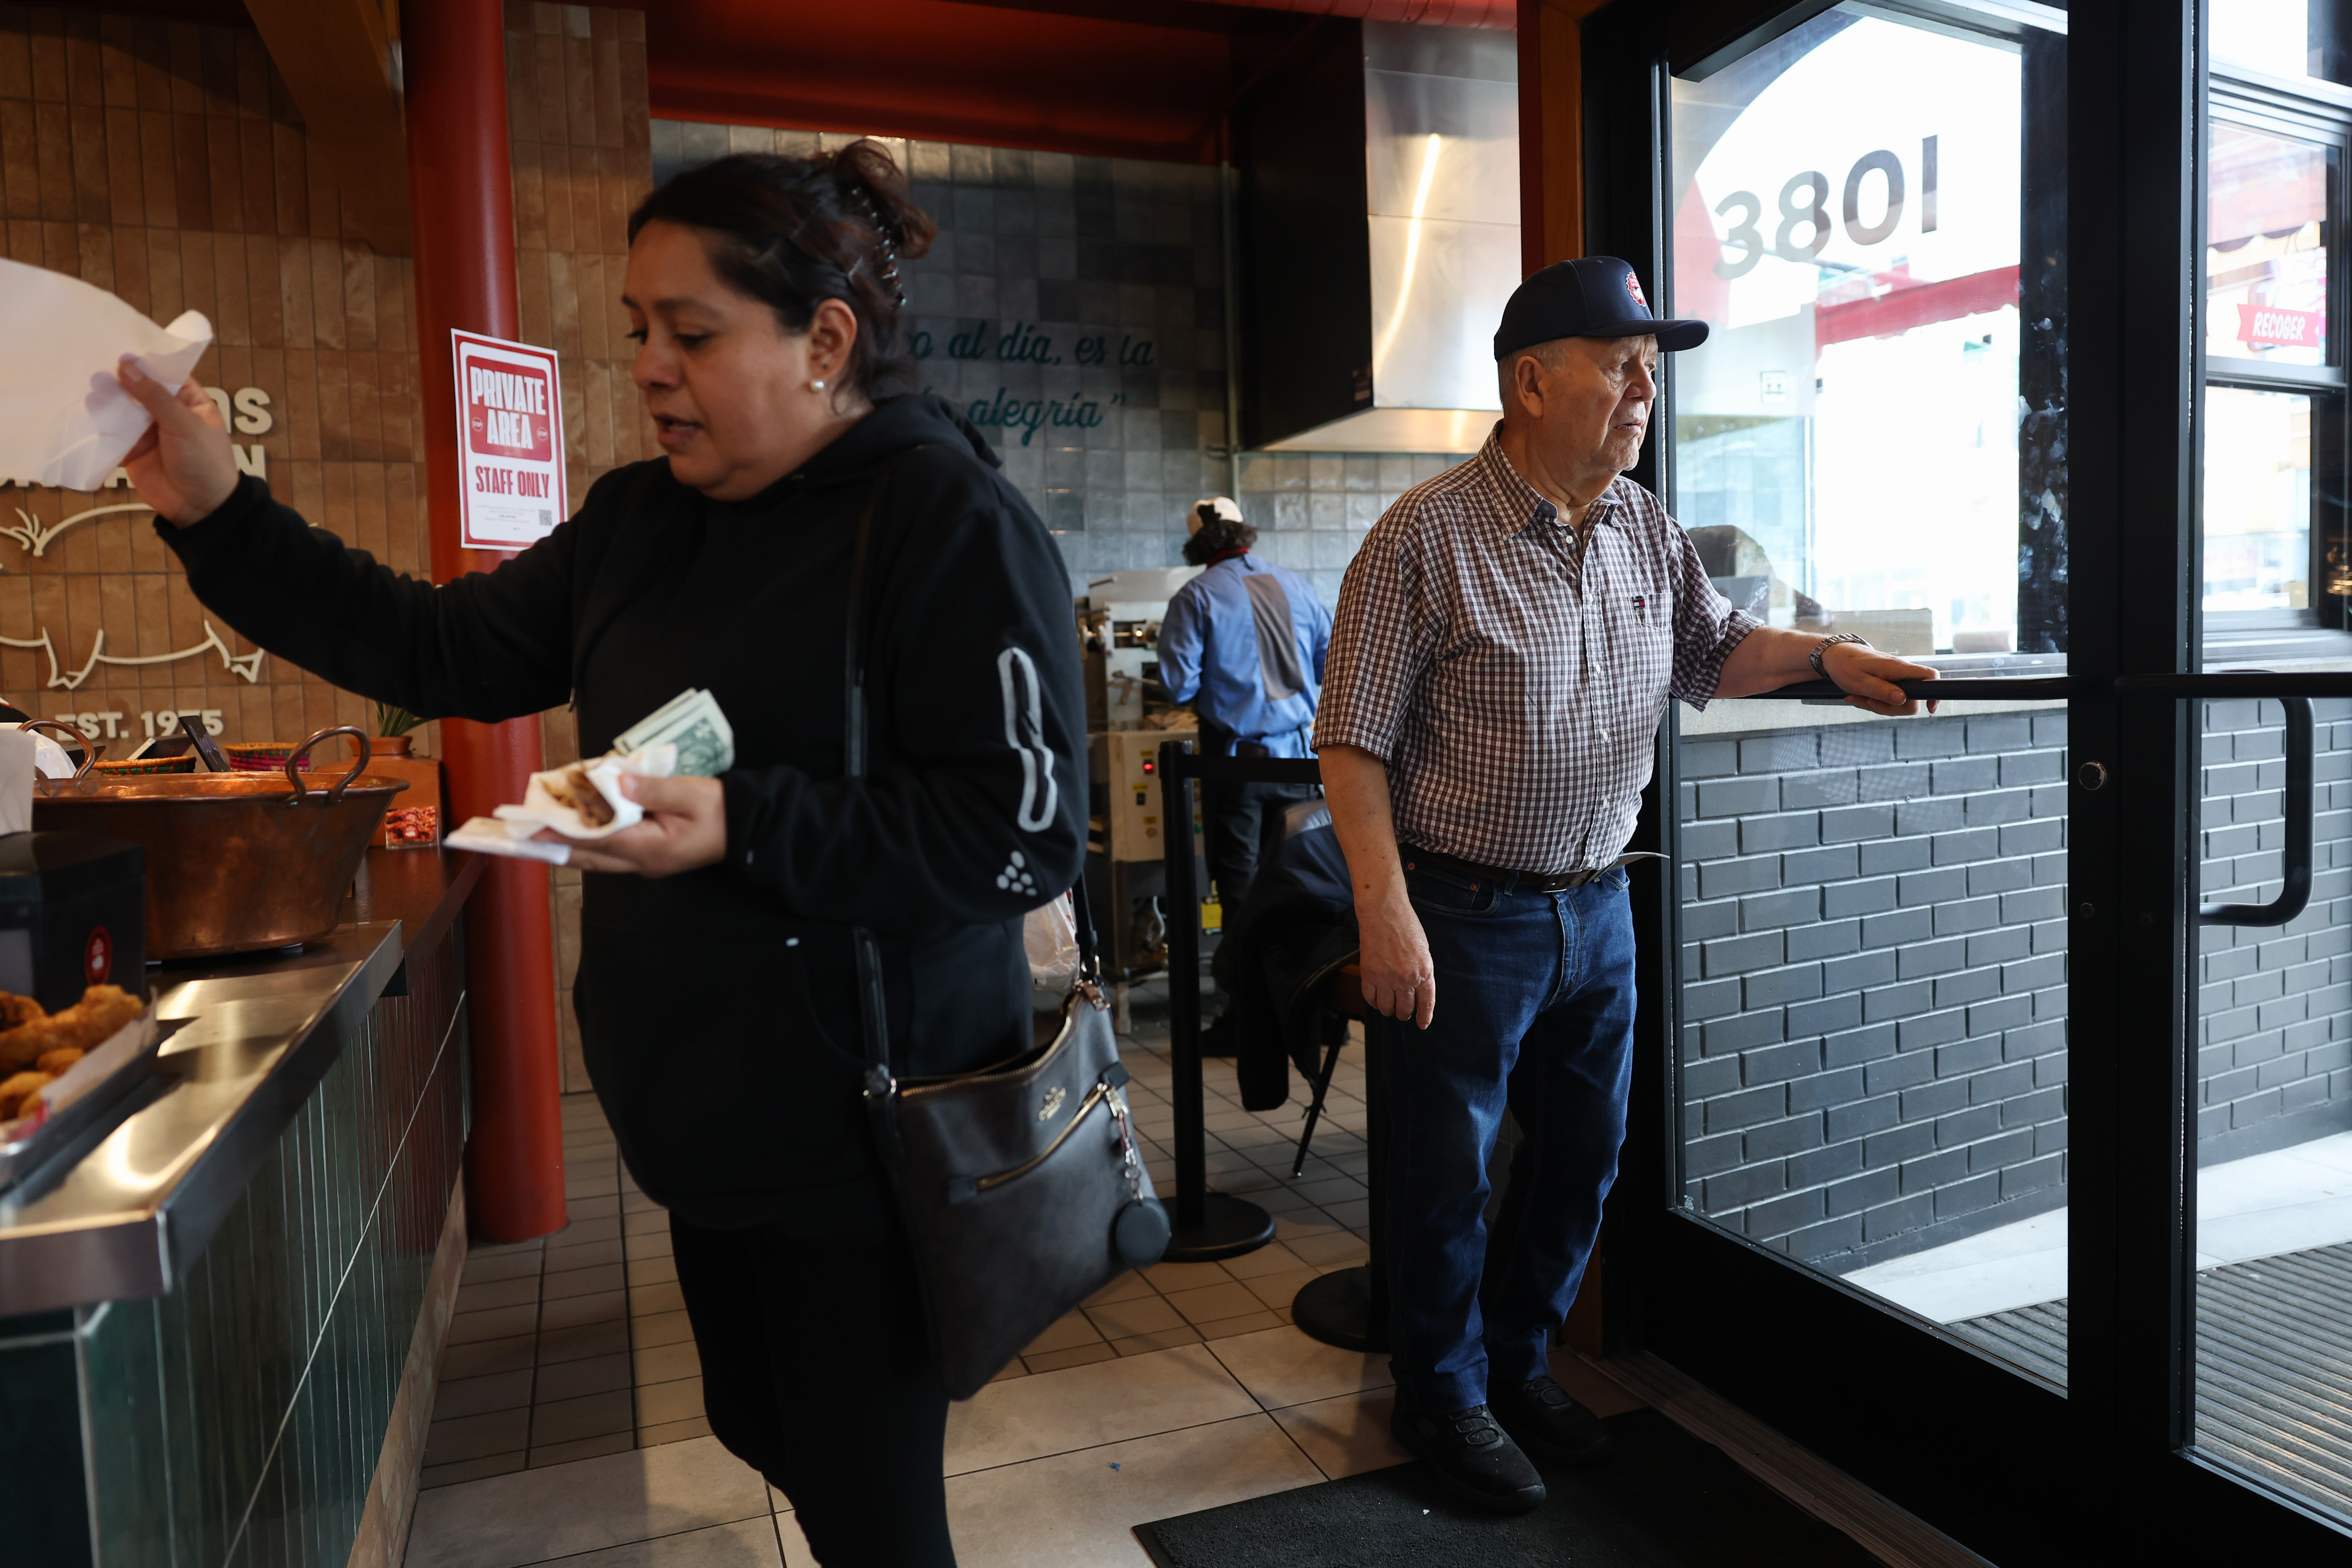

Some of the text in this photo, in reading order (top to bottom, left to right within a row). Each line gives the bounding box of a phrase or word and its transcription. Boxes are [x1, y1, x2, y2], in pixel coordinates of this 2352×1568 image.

[1714, 134, 1938, 280] 3801
[949, 320, 987, 360] al
[1075, 336, 1108, 365] es
[1120, 336, 1154, 366] la
[2253, 312, 2305, 340] RECOGER
[470, 366, 546, 416] PRIVATE
[487, 409, 534, 450] AREA
[475, 465, 549, 499] STAFF ONLY
[55, 712, 130, 742] EST.
